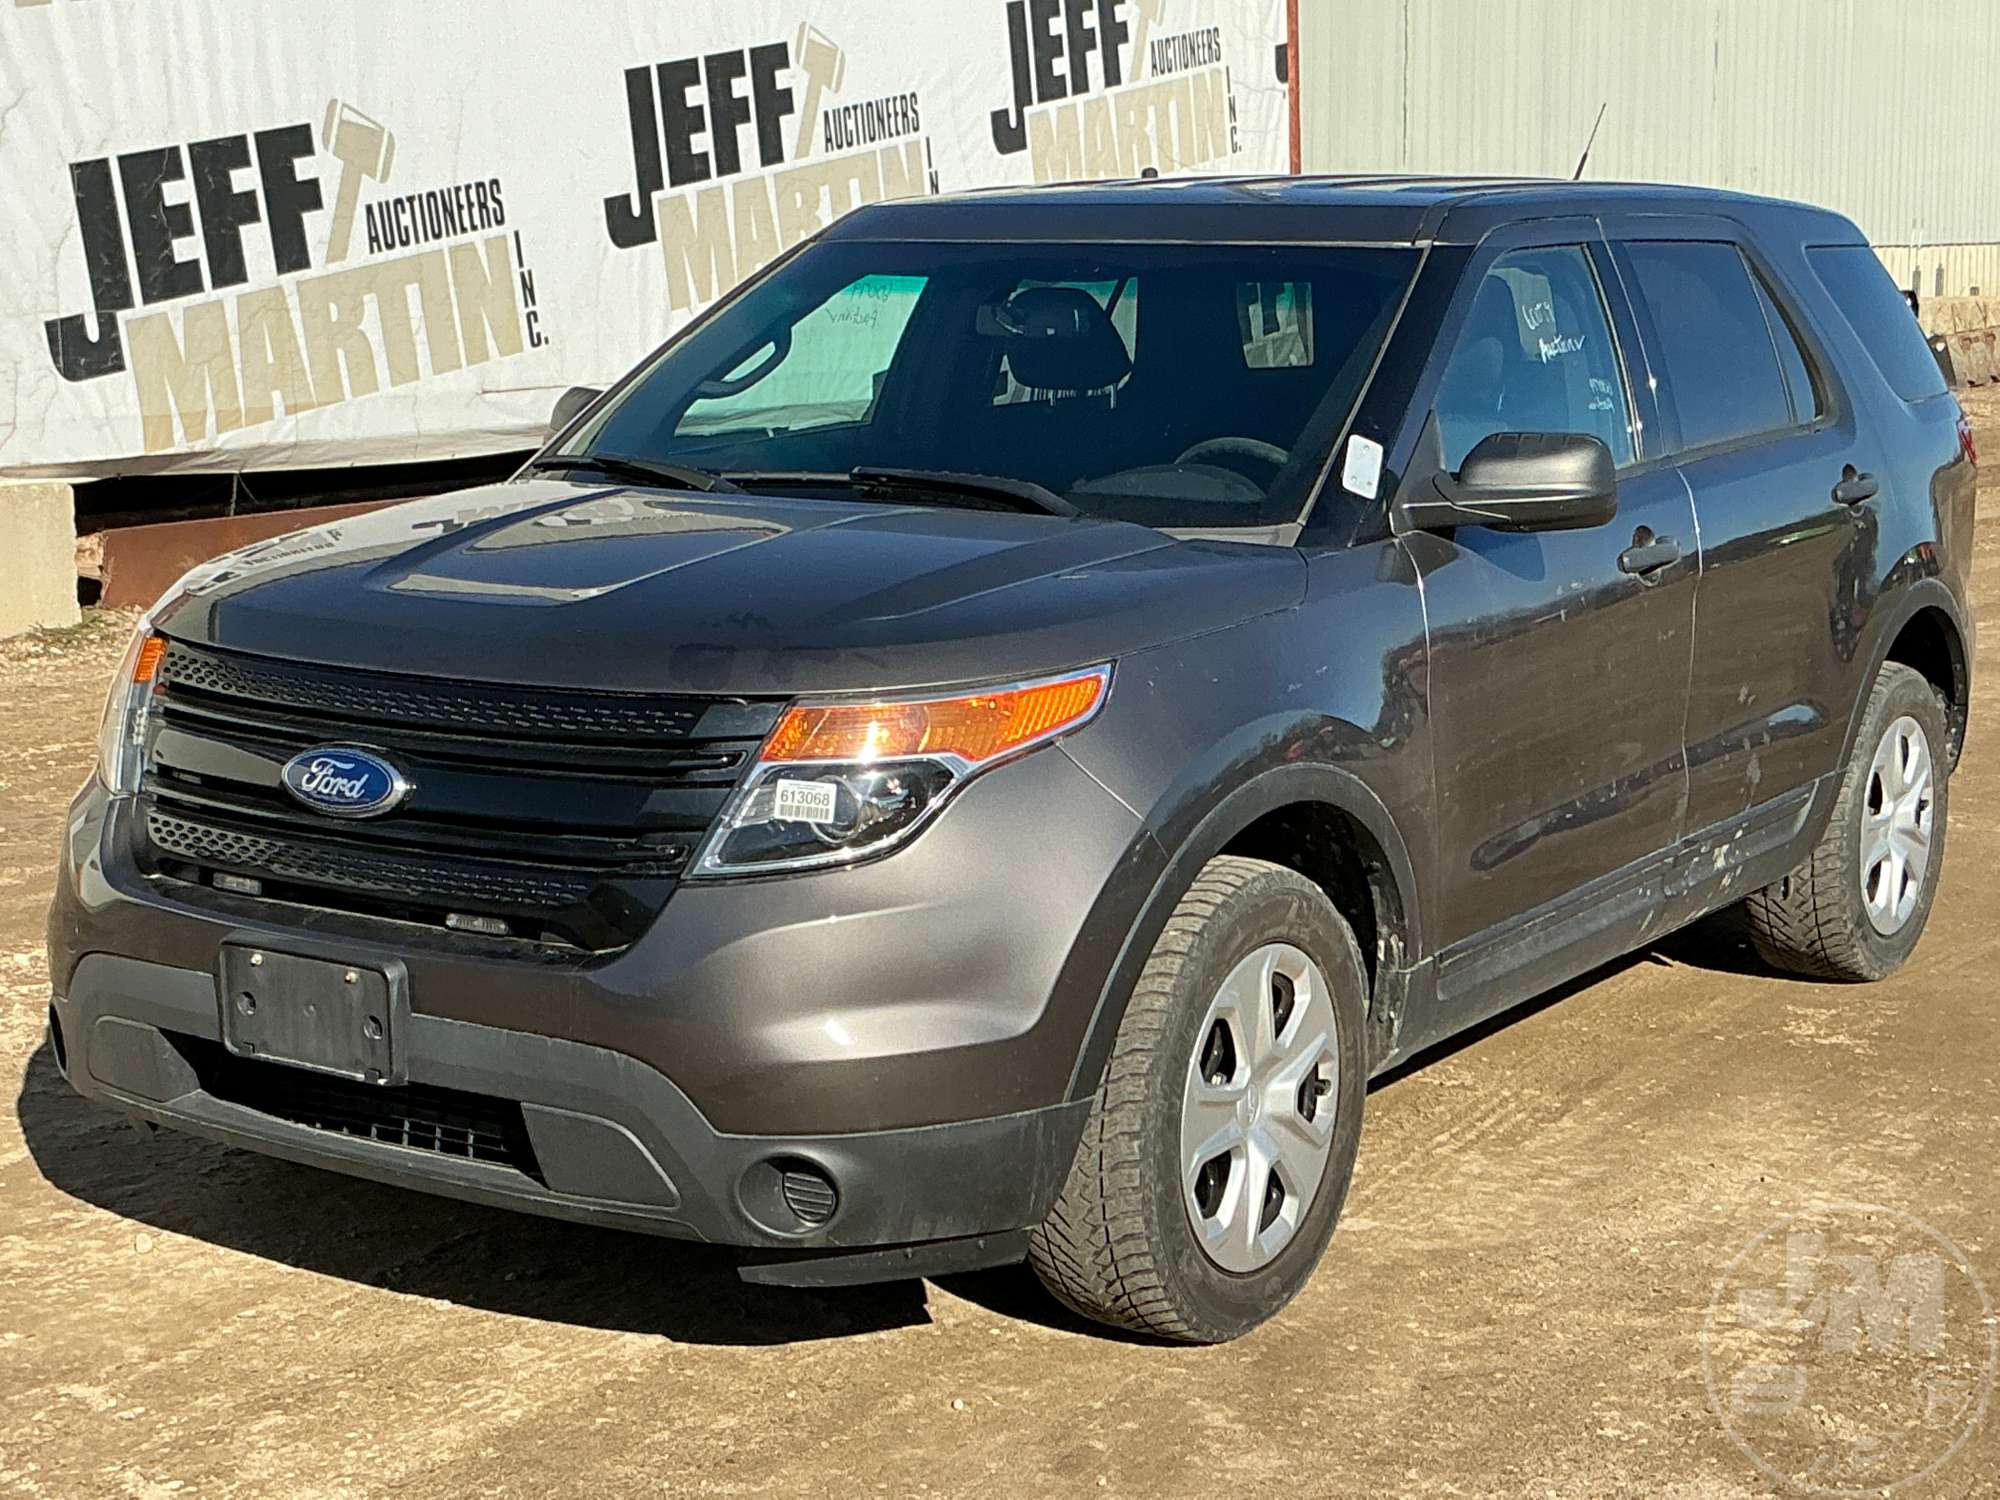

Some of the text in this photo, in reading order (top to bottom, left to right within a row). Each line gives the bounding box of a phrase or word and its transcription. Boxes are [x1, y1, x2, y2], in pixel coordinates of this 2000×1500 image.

[990, 0, 1128, 155] JEFF
[1151, 27, 1221, 77] AUCTIONEERS
[604, 41, 794, 249] JEFF
[824, 92, 919, 152] AUCTIONEERS
[1029, 68, 1227, 184] MARTIN
[44, 122, 324, 382] JEFF
[365, 178, 505, 254] AUCTIONEERS
[125, 235, 523, 452] MARTIN
[515, 231, 549, 349] INC.
[302, 757, 369, 798] Ford
[780, 789, 830, 806] 613068
